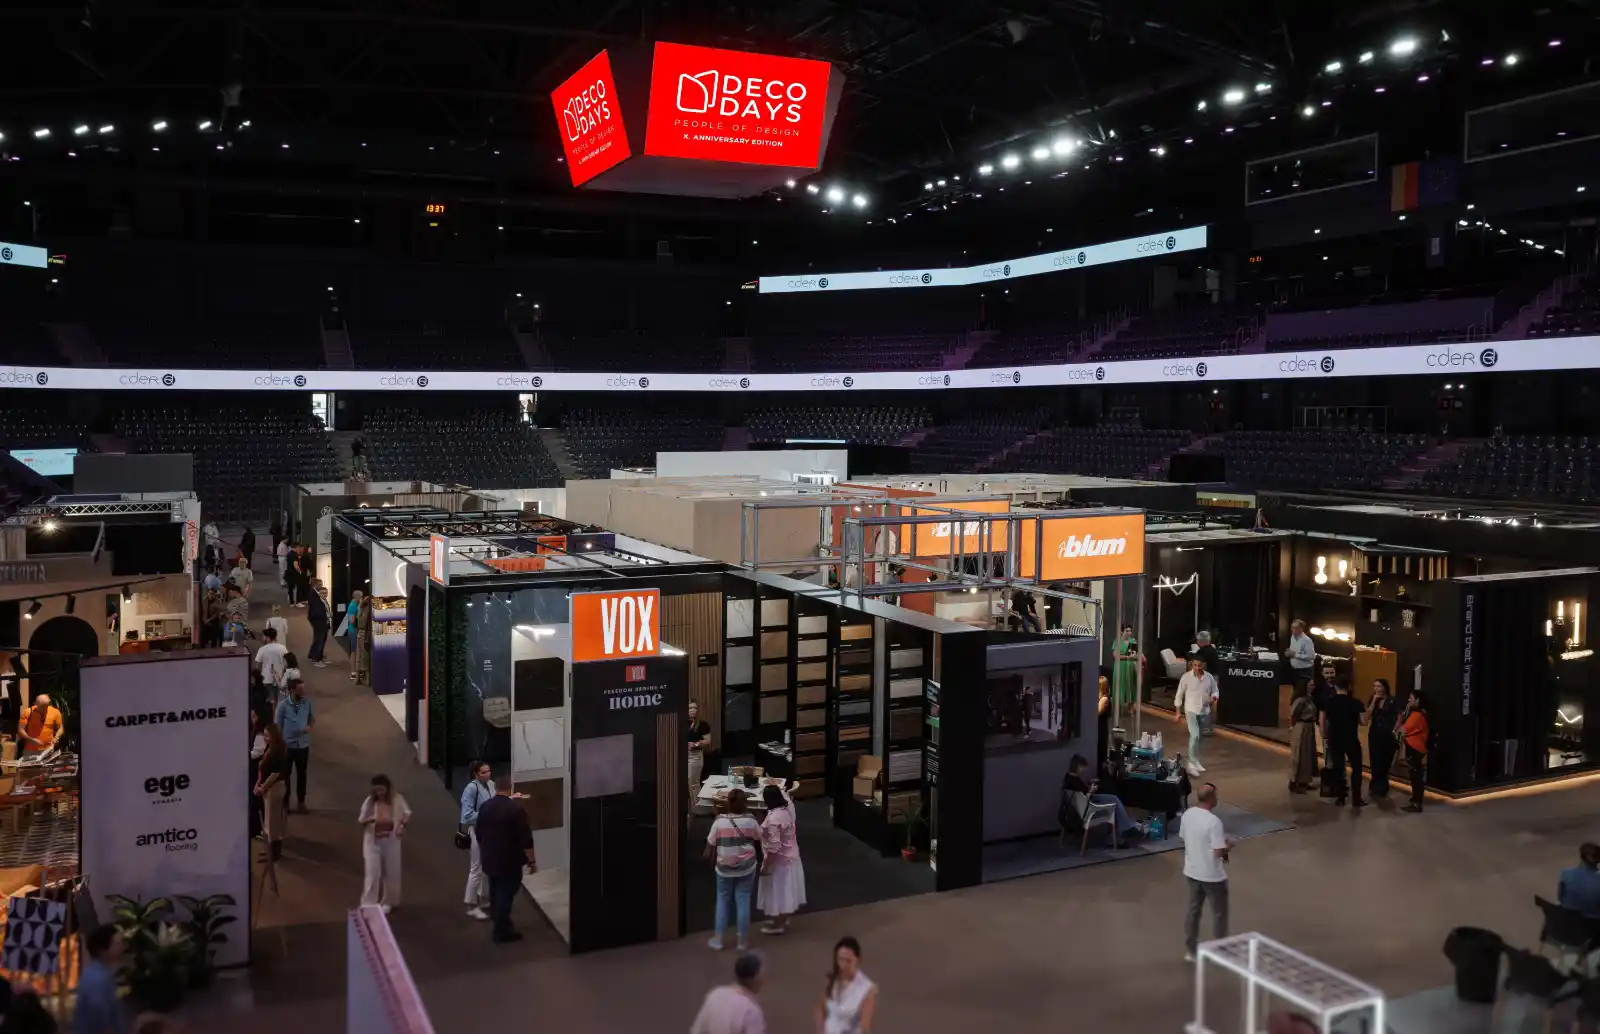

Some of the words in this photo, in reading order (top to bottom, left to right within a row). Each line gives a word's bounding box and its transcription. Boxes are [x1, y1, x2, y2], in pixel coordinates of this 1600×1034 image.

[574, 79, 606, 114] DECO
[722, 74, 807, 102] DECO
[579, 100, 611, 135] DAYS
[719, 96, 802, 123] DAYS
[674, 119, 723, 130] PEOPLE
[732, 124, 747, 132] OF
[755, 126, 800, 137] DESIGN
[693, 134, 750, 145] ANNIVERSARY
[751, 139, 783, 147] EDITION
[1063, 534, 1127, 558] blum
[601, 595, 654, 655] VOX
[1465, 594, 1475, 634] Brand
[1464, 636, 1473, 663] that
[105, 706, 227, 728] CARPET&MORE
[144, 773, 190, 797] ege
[136, 828, 198, 846] amtico
